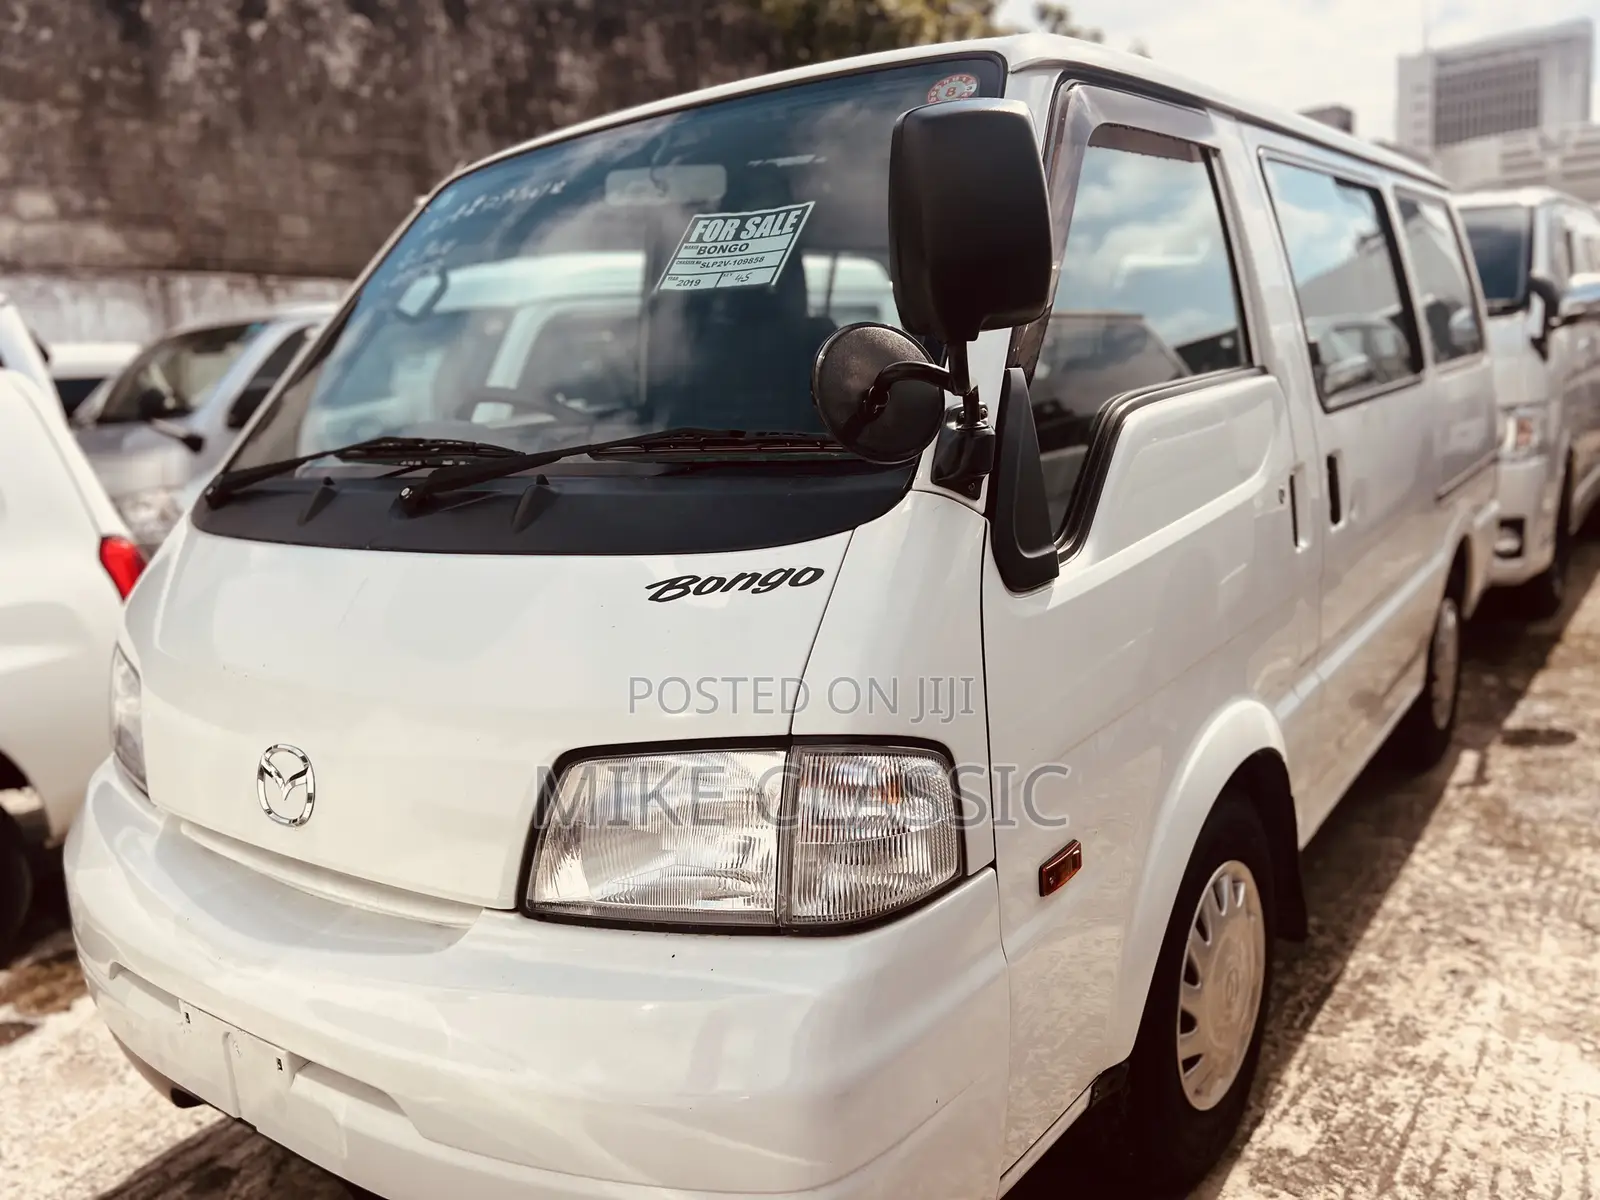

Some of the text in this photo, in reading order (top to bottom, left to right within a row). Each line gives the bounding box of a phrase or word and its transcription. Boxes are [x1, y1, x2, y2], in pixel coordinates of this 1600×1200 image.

[689, 210, 802, 243] FOR SALE
[697, 243, 749, 256] BONGO
[676, 279, 701, 287] 2019
[645, 566, 825, 602] Bongo
